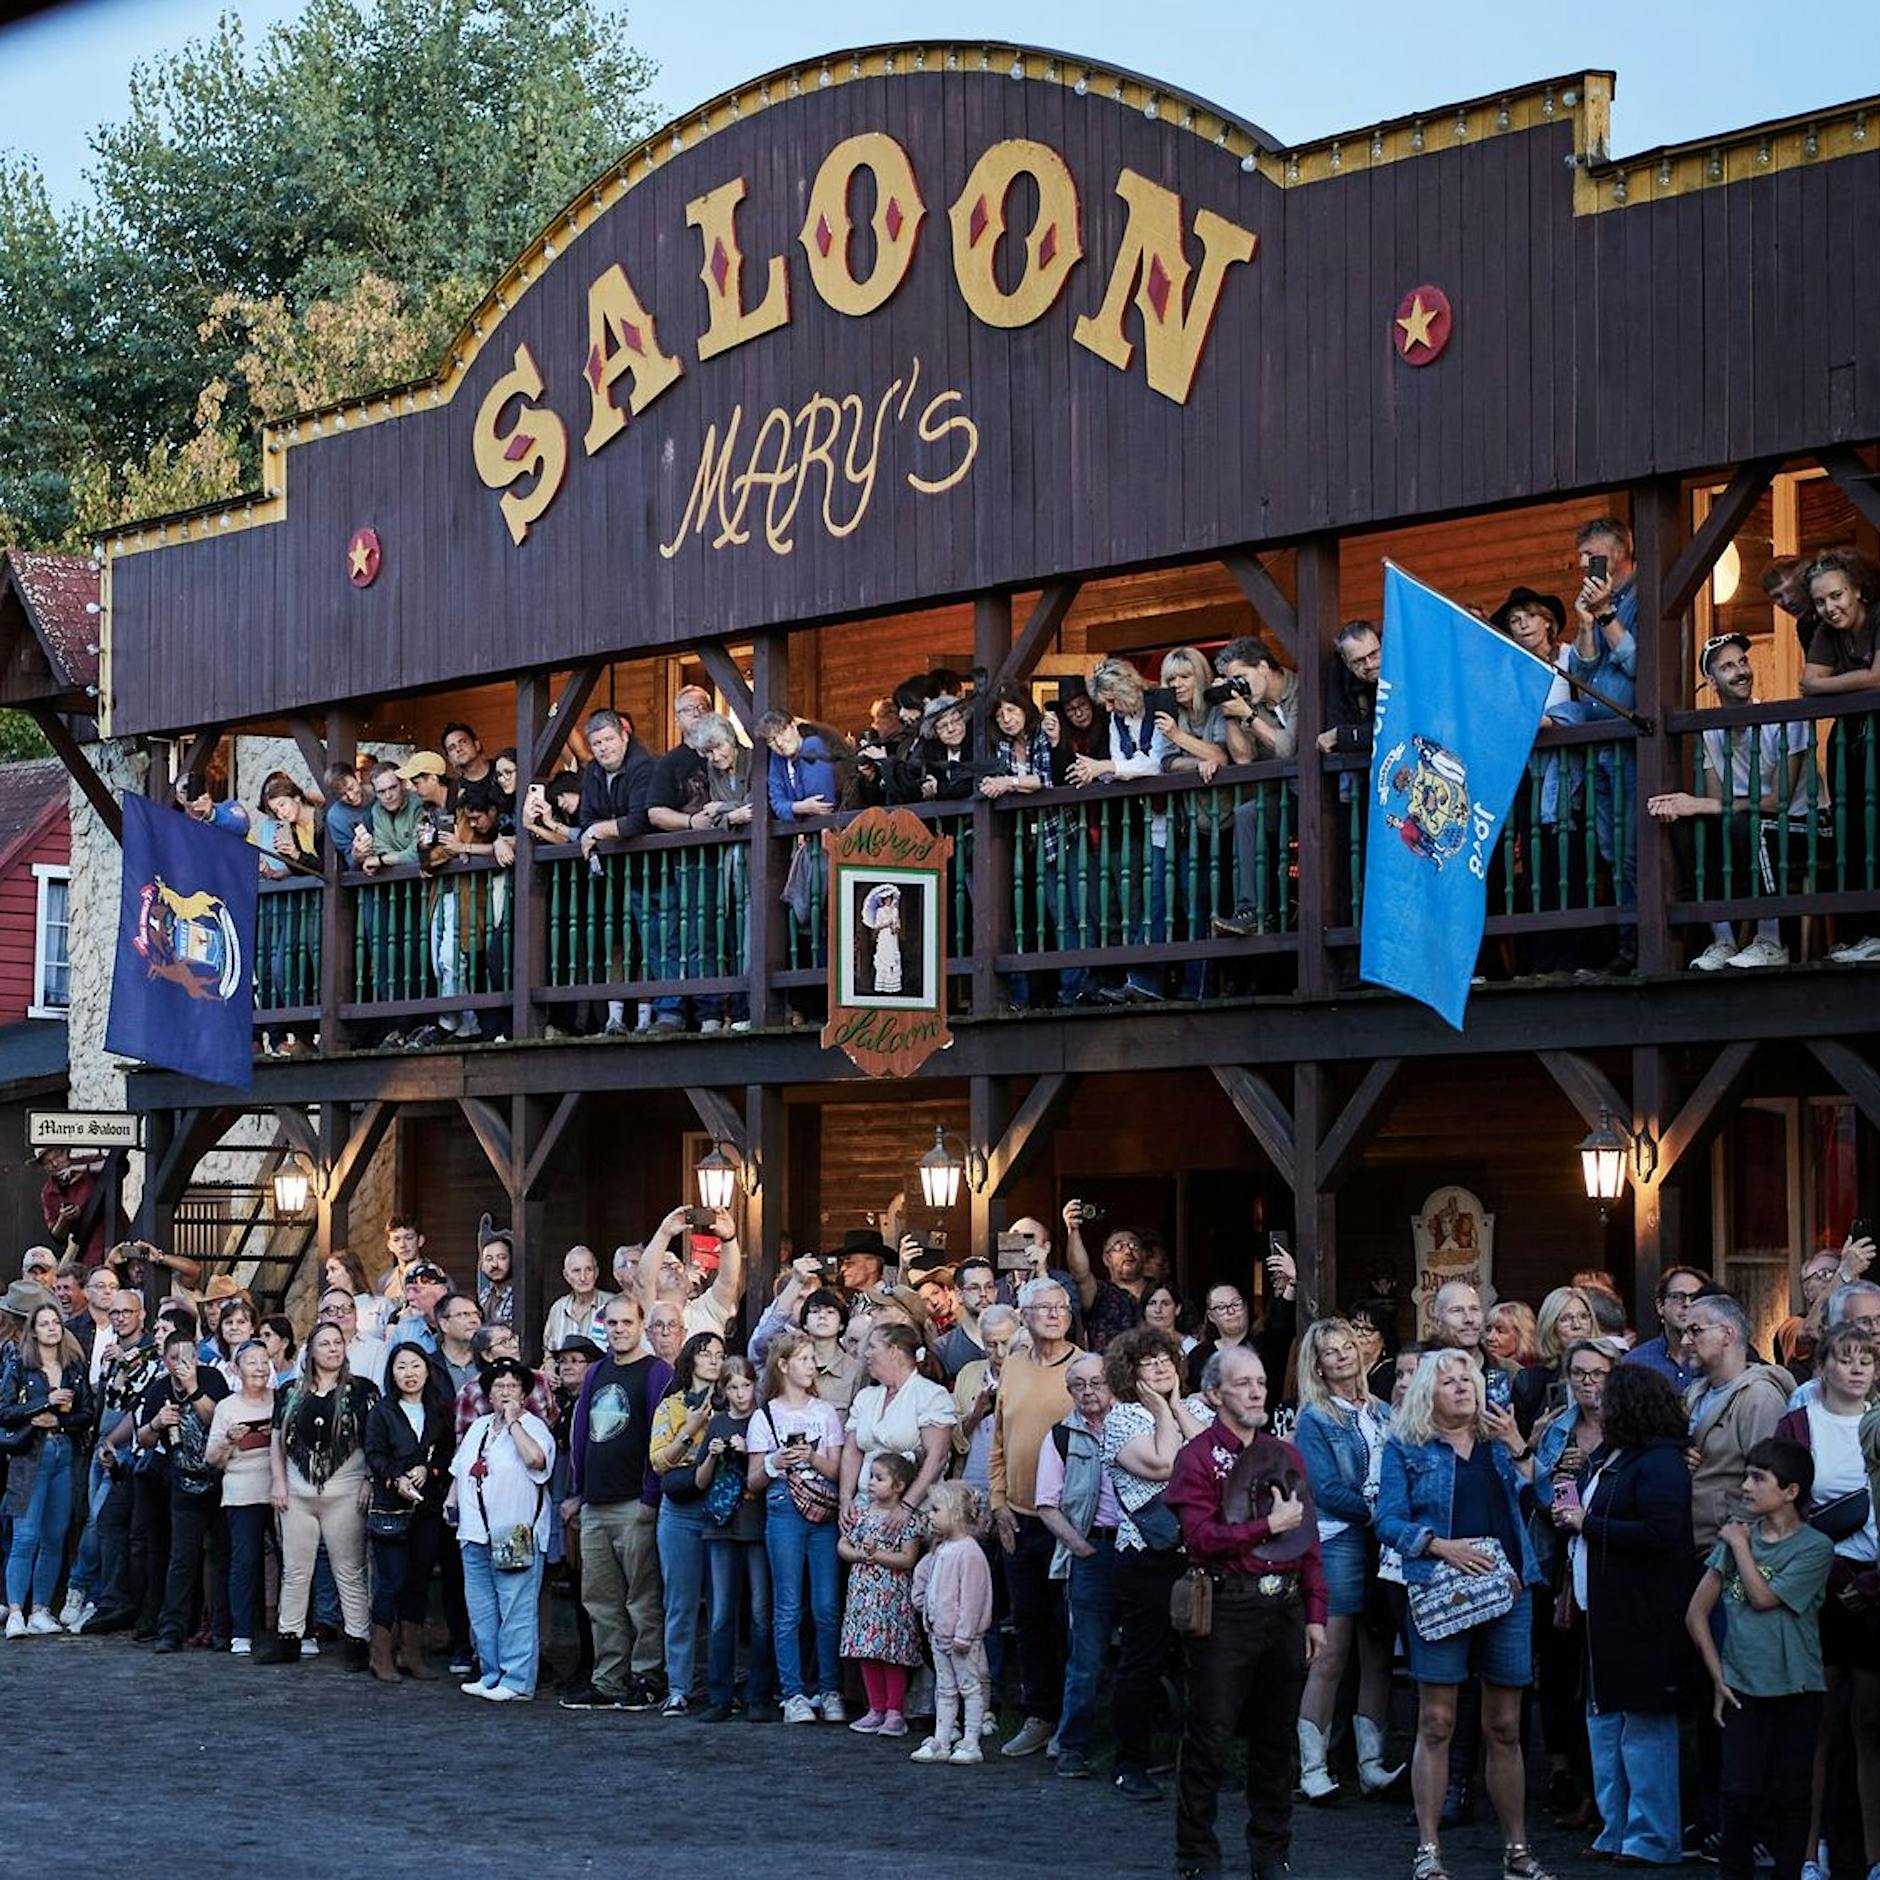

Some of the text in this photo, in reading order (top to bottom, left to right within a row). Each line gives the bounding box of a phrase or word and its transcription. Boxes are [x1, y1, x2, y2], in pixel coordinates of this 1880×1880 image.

[472, 131, 1260, 547] SALOON
[659, 356, 979, 558] MARY'S
[38, 1120, 131, 1138] Mary's Saloon
